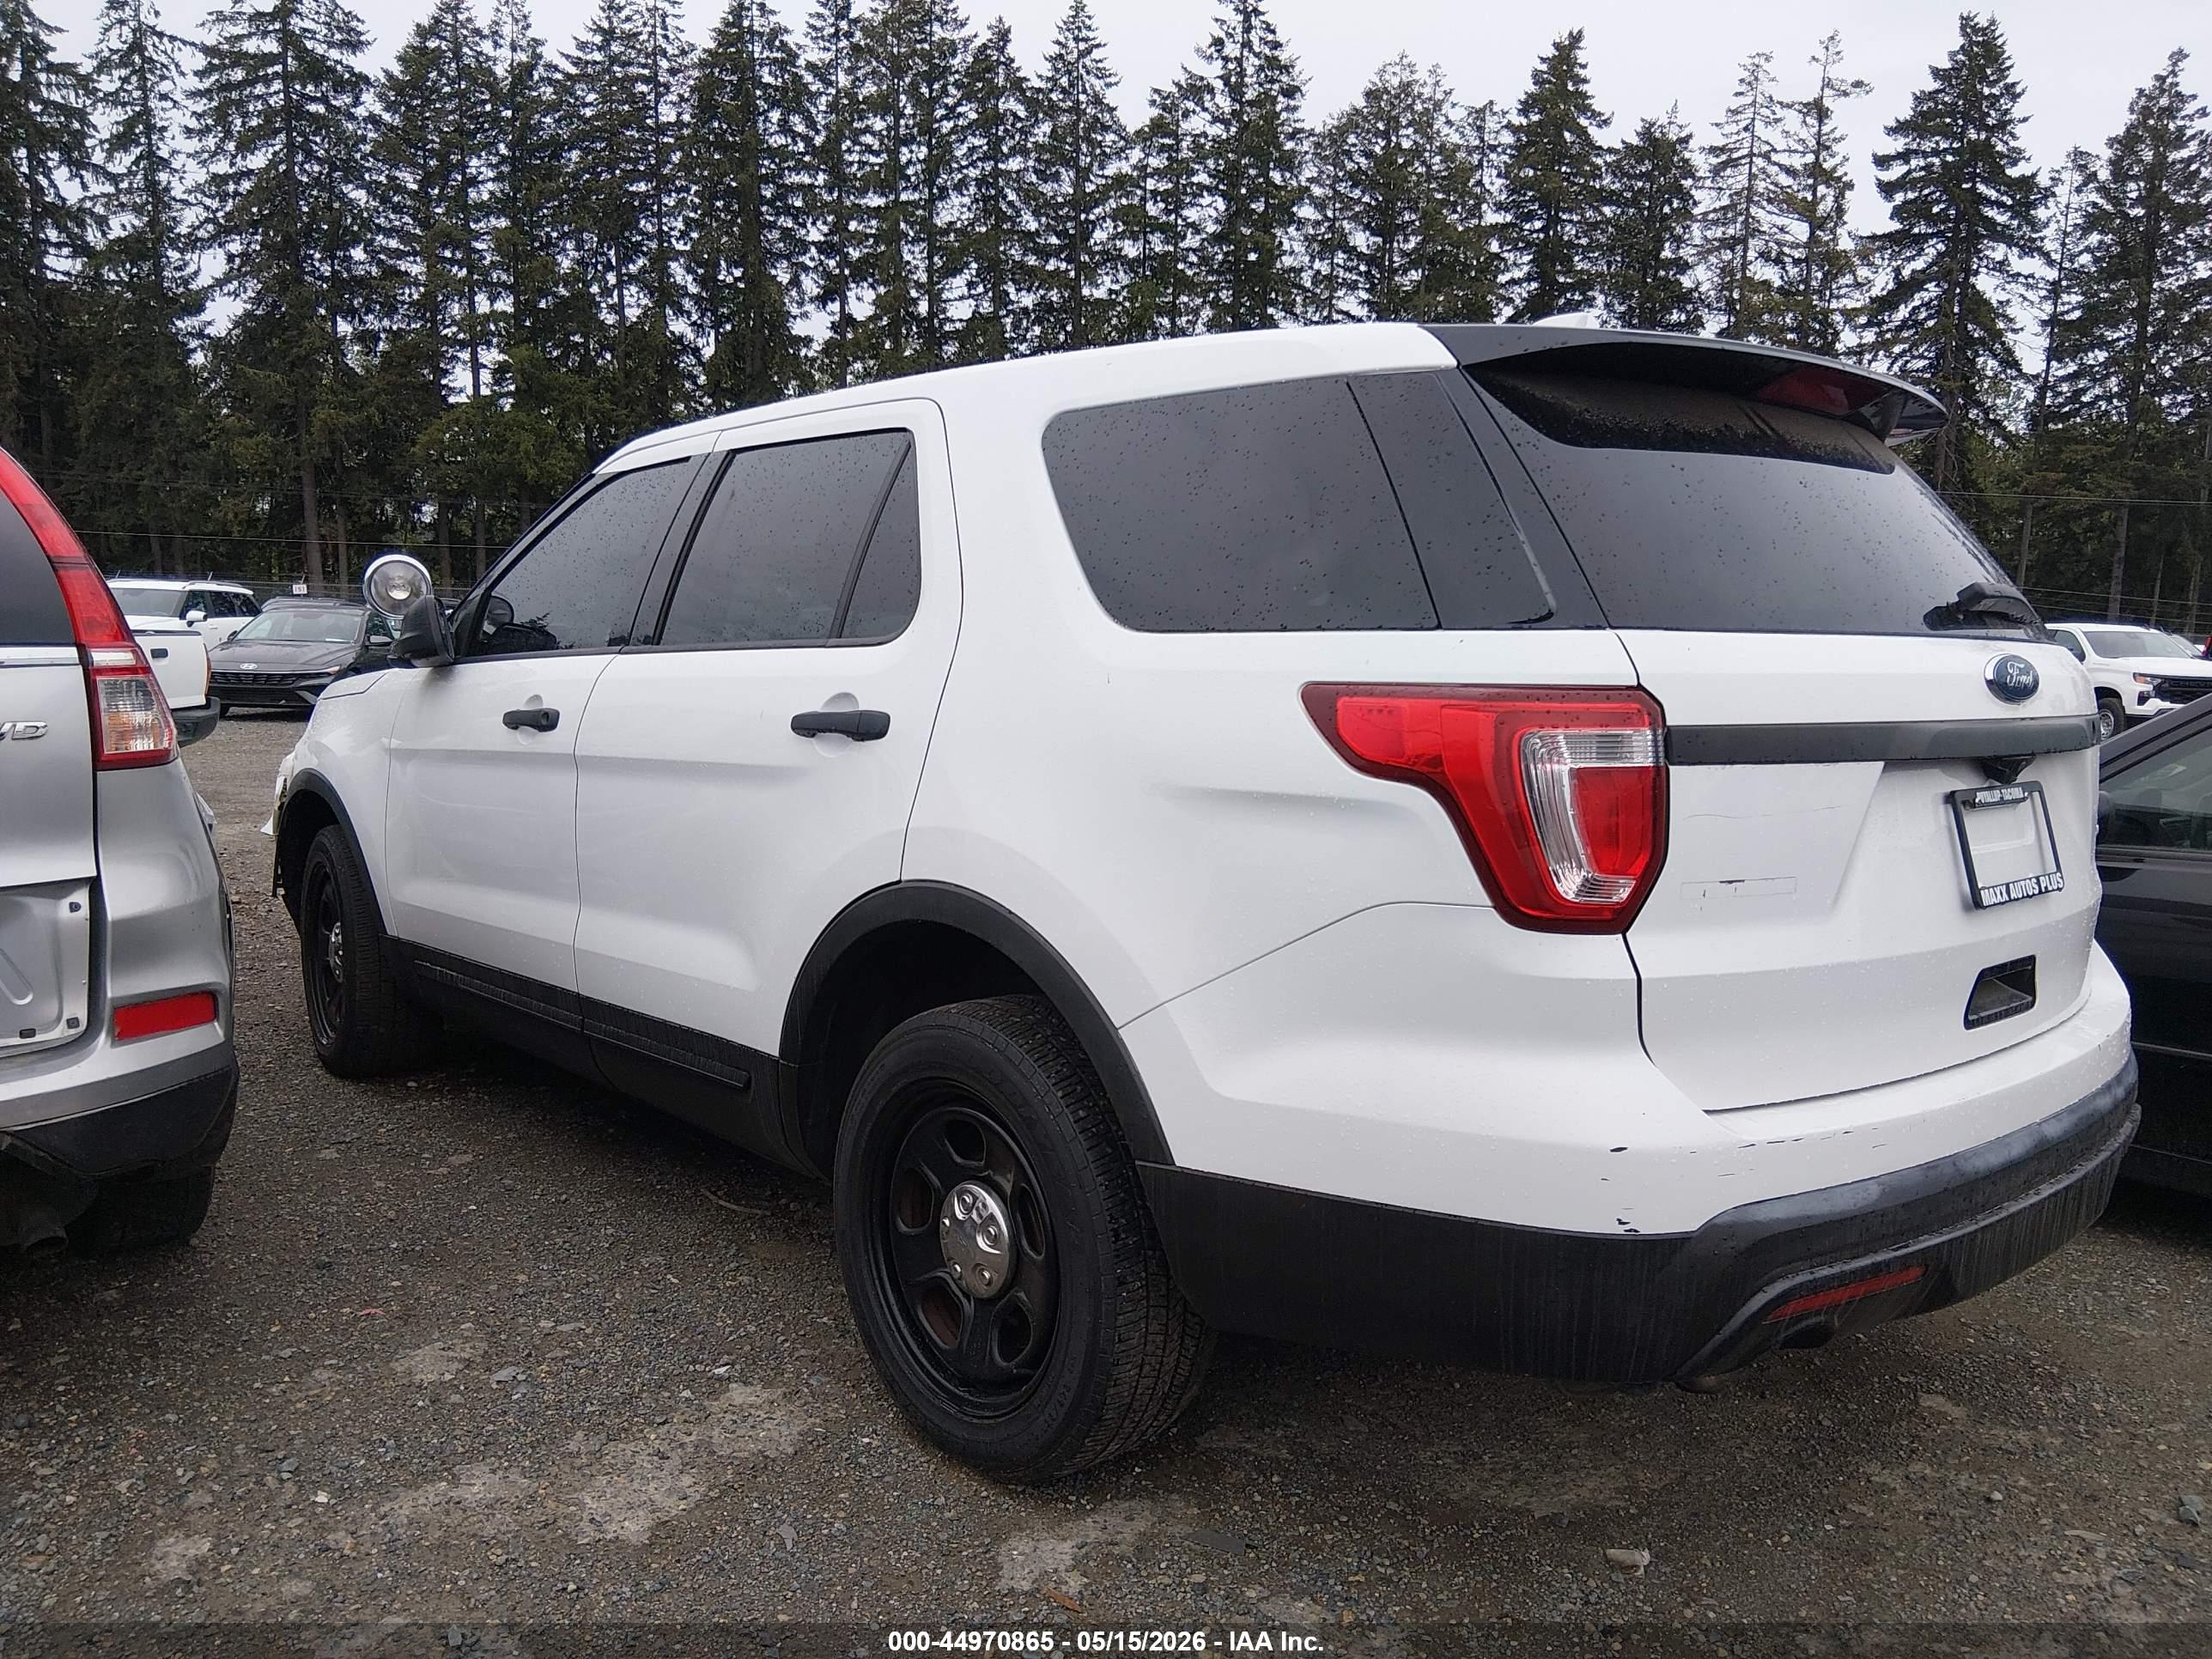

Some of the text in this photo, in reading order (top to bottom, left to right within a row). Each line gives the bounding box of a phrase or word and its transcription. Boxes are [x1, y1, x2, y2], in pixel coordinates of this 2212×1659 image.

[2007, 661, 2033, 689] Ford
[1979, 872, 2063, 907] MAXX AUTOS PLUS
